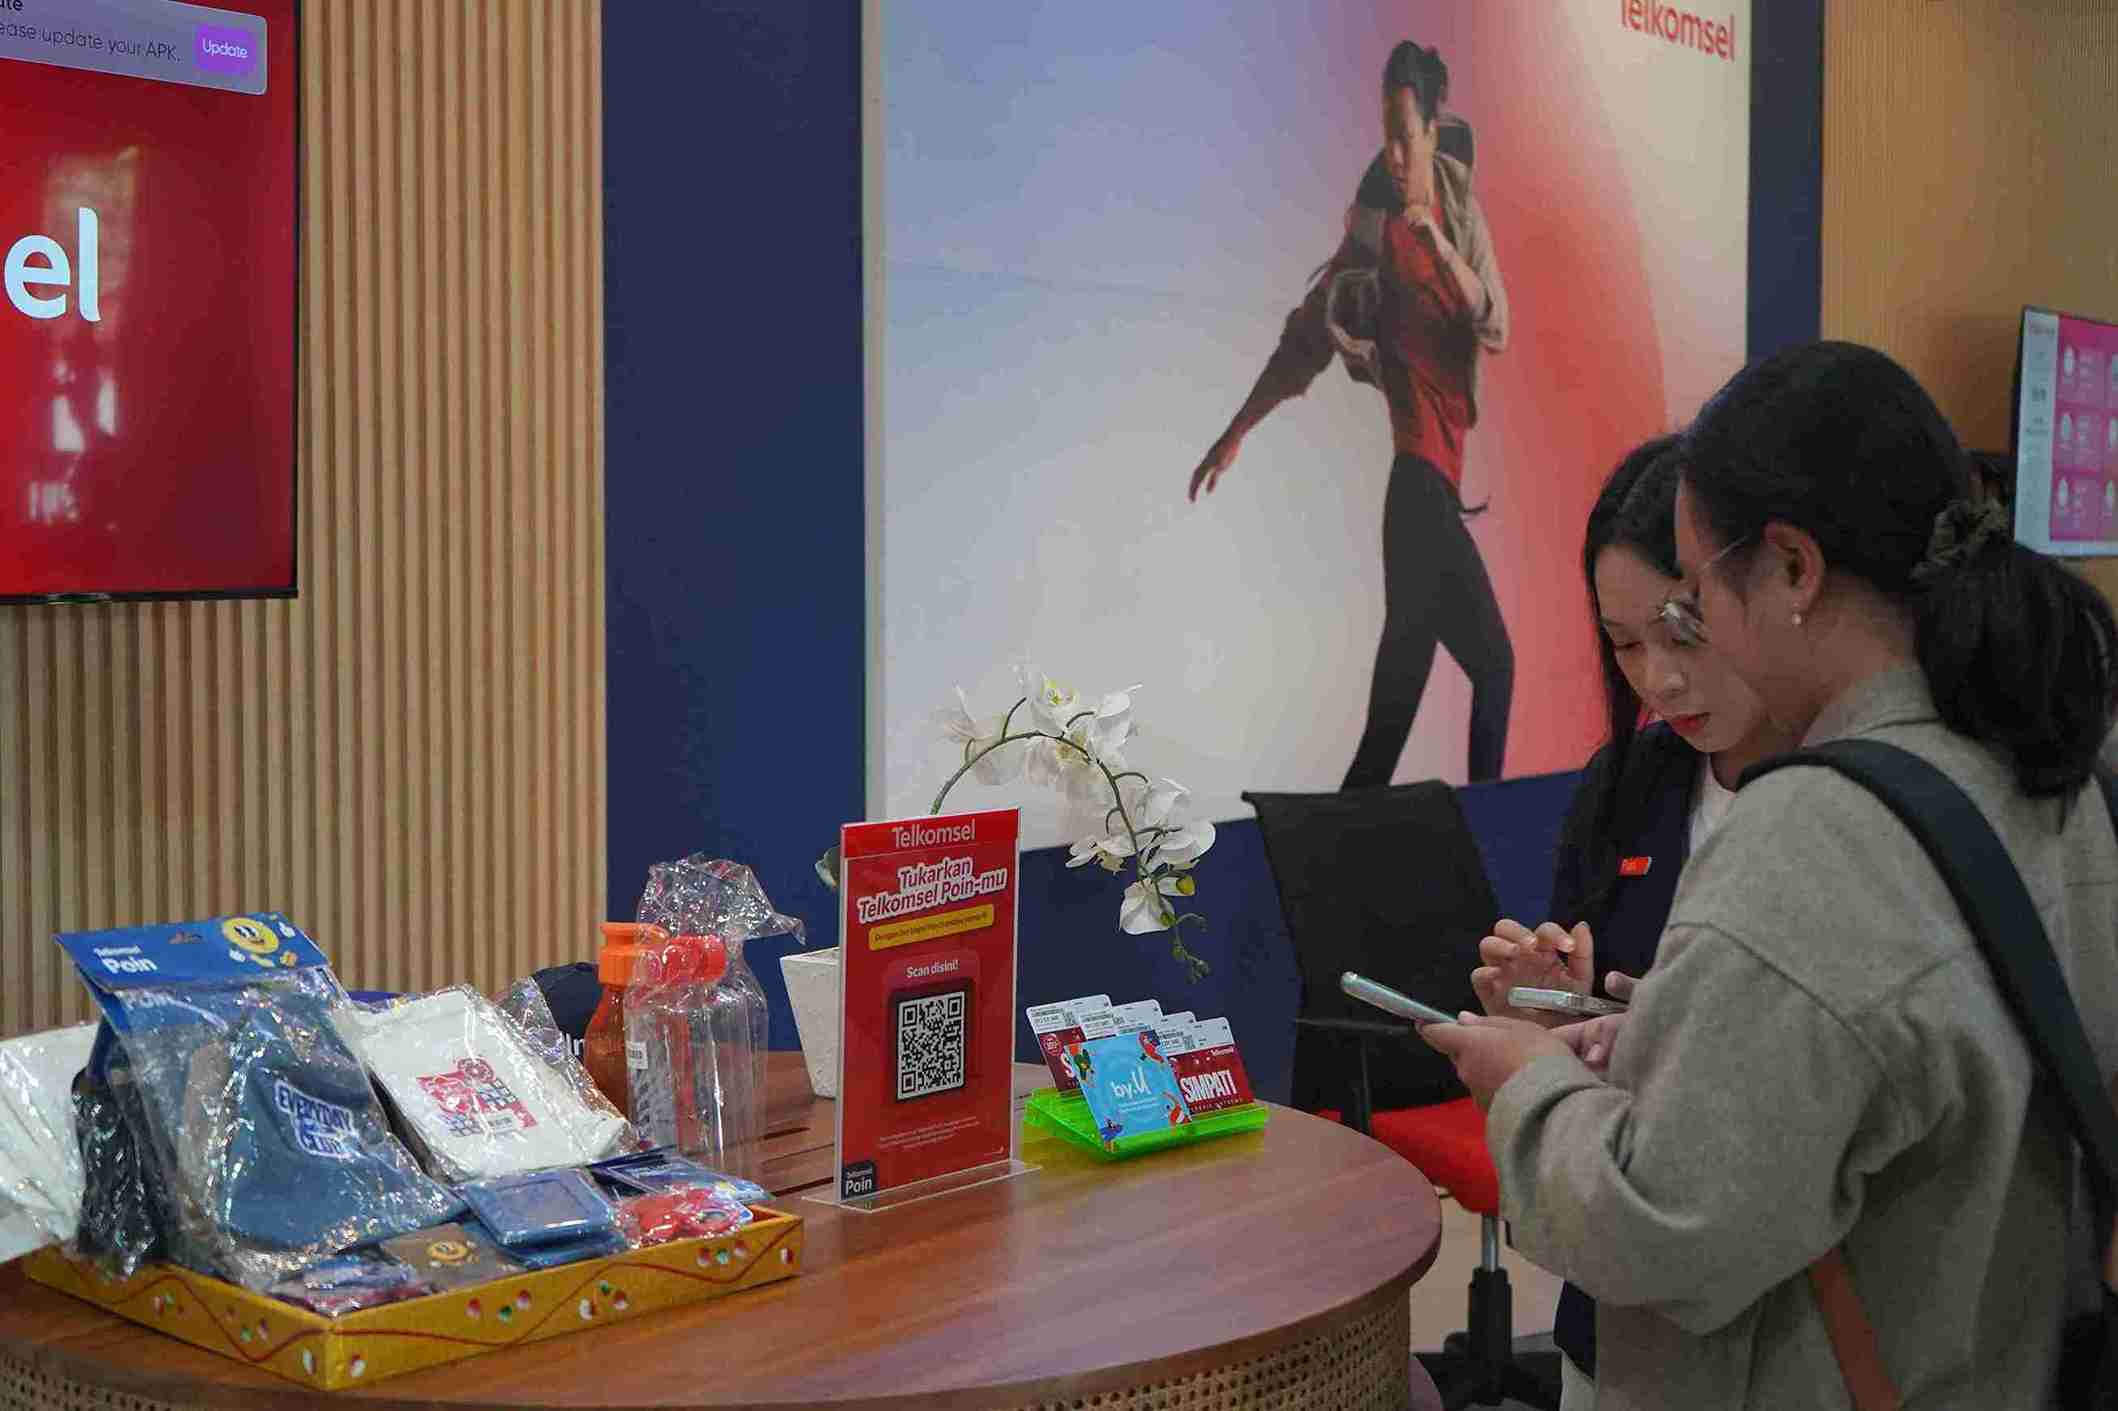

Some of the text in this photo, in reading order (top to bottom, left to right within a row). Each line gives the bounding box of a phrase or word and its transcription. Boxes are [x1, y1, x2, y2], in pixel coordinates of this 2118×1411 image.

[42, 27, 104, 49] update
[108, 38, 141, 56] your
[202, 38, 249, 59] Update
[3, 207, 102, 322] el
[893, 818, 976, 848] Telkomsel
[899, 858, 972, 890] Tukarkan
[859, 870, 1006, 920] Telkomsel Poin-mu
[102, 956, 157, 974] Poin
[906, 959, 959, 978] Scan disini!
[1181, 1069, 1237, 1103] SIMPATI
[279, 1084, 354, 1135] EVERYDAY
[845, 1178, 872, 1195] Poin
